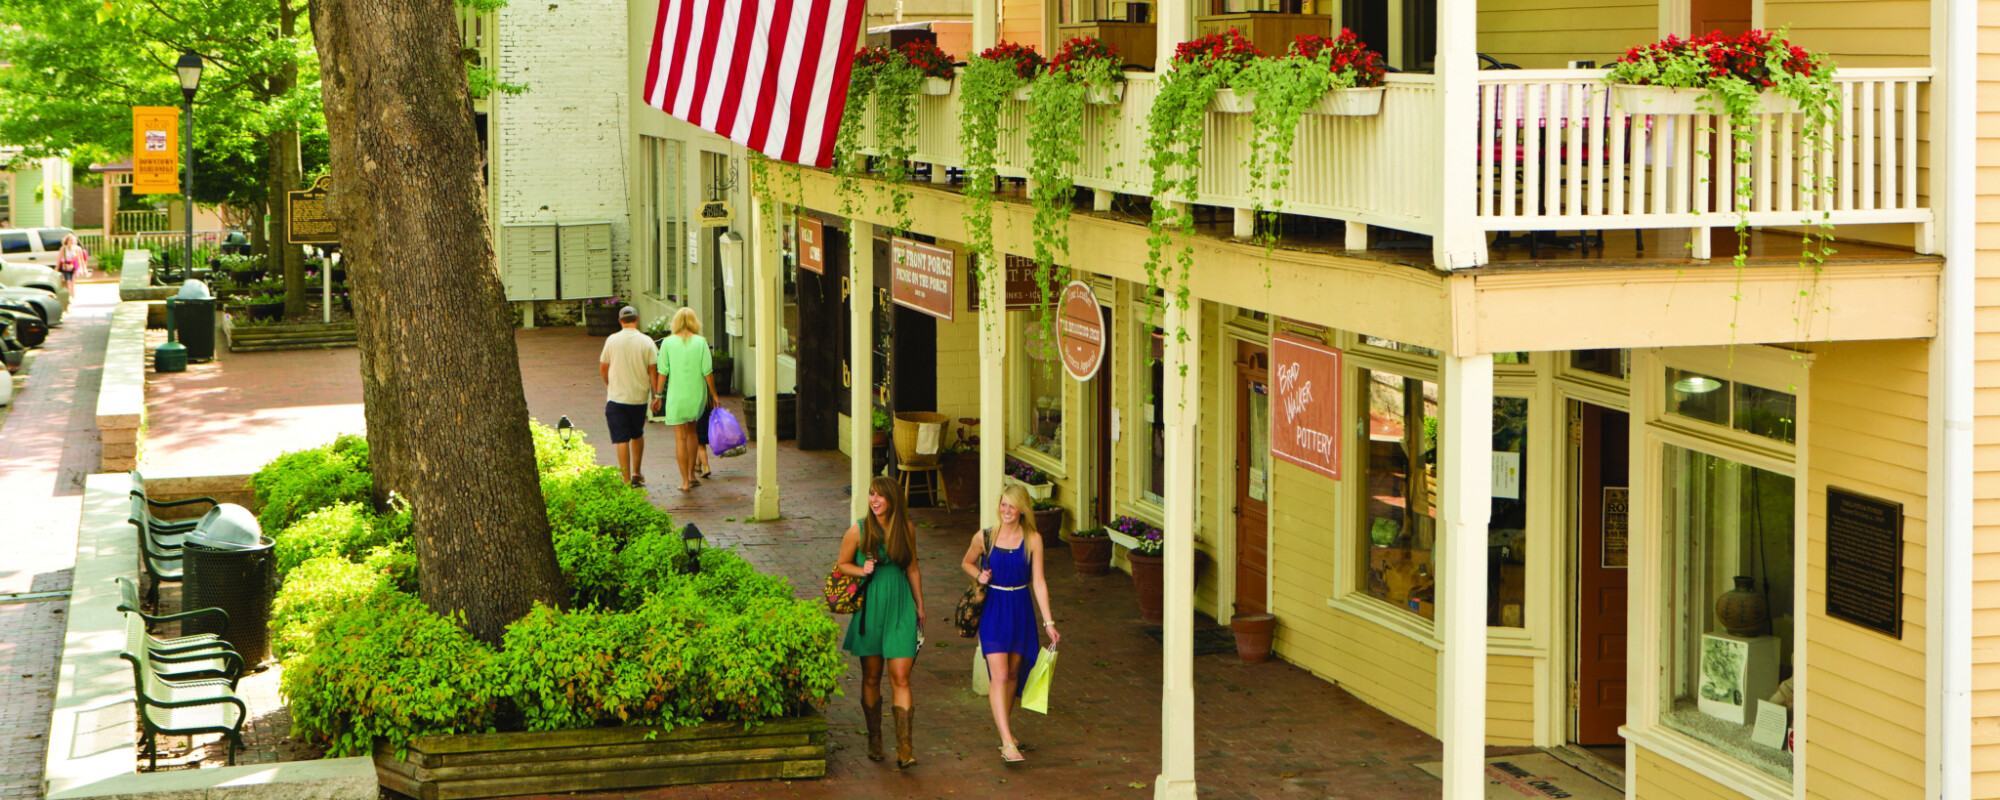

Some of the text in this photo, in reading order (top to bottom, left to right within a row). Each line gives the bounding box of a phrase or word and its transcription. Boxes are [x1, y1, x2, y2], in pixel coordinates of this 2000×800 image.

[906, 250, 926, 270] FRONT
[928, 255, 952, 276] PORCH
[1006, 256, 1033, 267] THE
[912, 272, 918, 285] ON
[919, 274, 929, 288] THE
[930, 276, 947, 294] PORCH
[1024, 268, 1060, 282] POC
[1090, 327, 1100, 341] IRON
[1278, 362, 1300, 395] BRAD
[1284, 380, 1314, 424] WALKER
[1296, 426, 1333, 464] POTTERY
